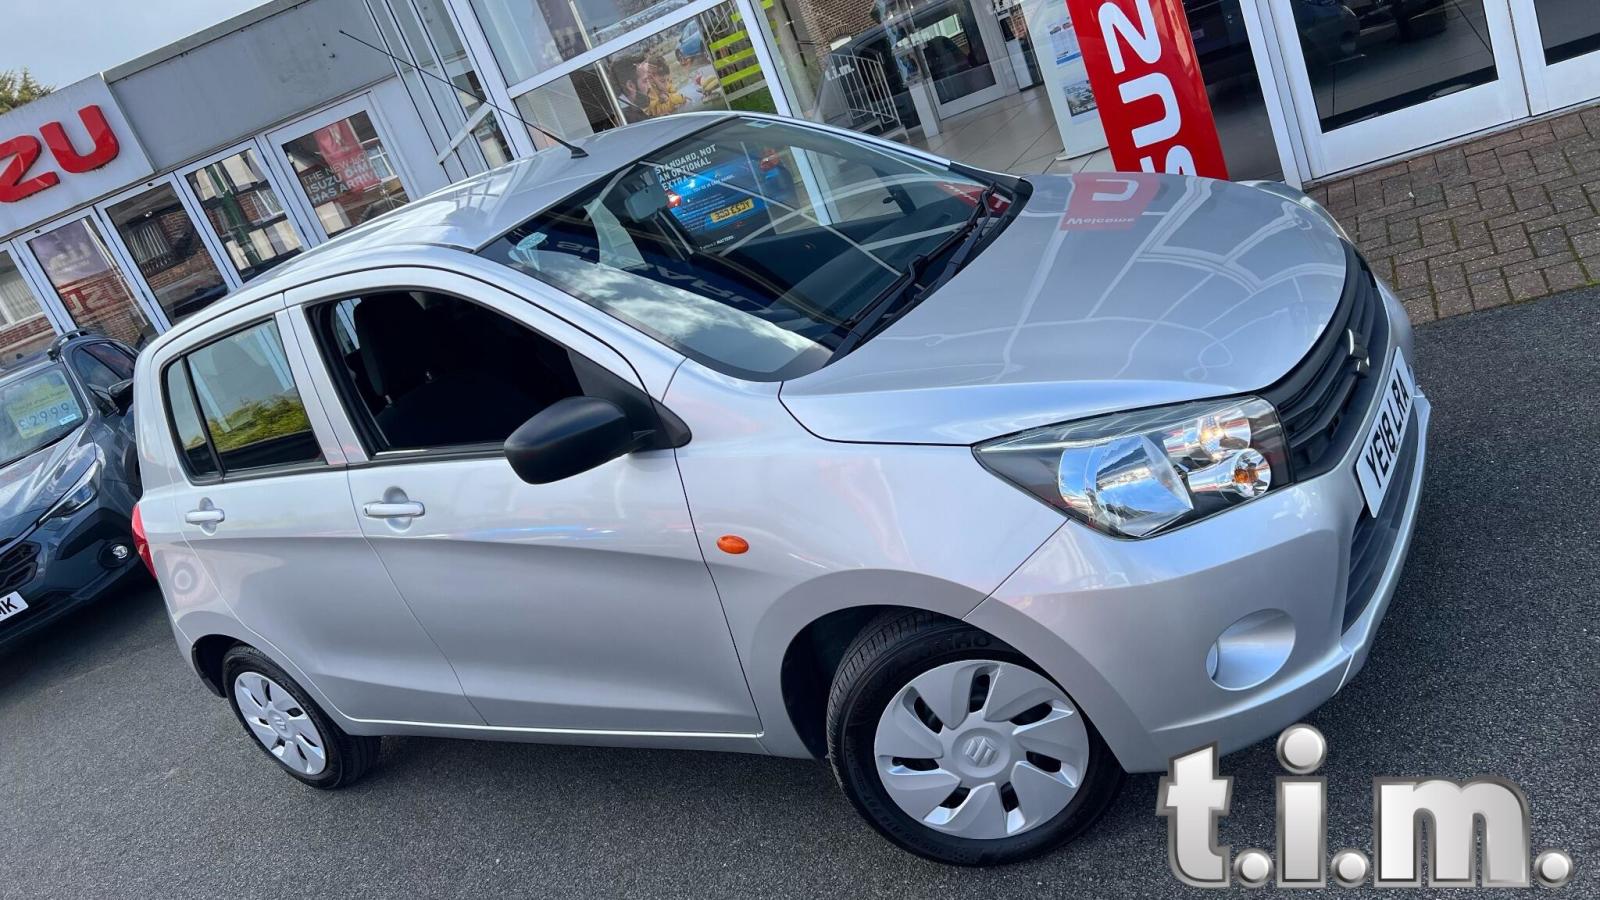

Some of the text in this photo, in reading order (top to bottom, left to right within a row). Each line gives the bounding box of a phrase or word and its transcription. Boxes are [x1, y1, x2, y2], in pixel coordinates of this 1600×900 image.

[656, 144, 717, 174] STANDARD, NOT
[303, 170, 323, 185] THE
[659, 159, 711, 183] AN OPTIONAL
[306, 174, 342, 194] ISUZU
[311, 187, 337, 203] HAS
[1365, 367, 1410, 488] YE18 LRA
